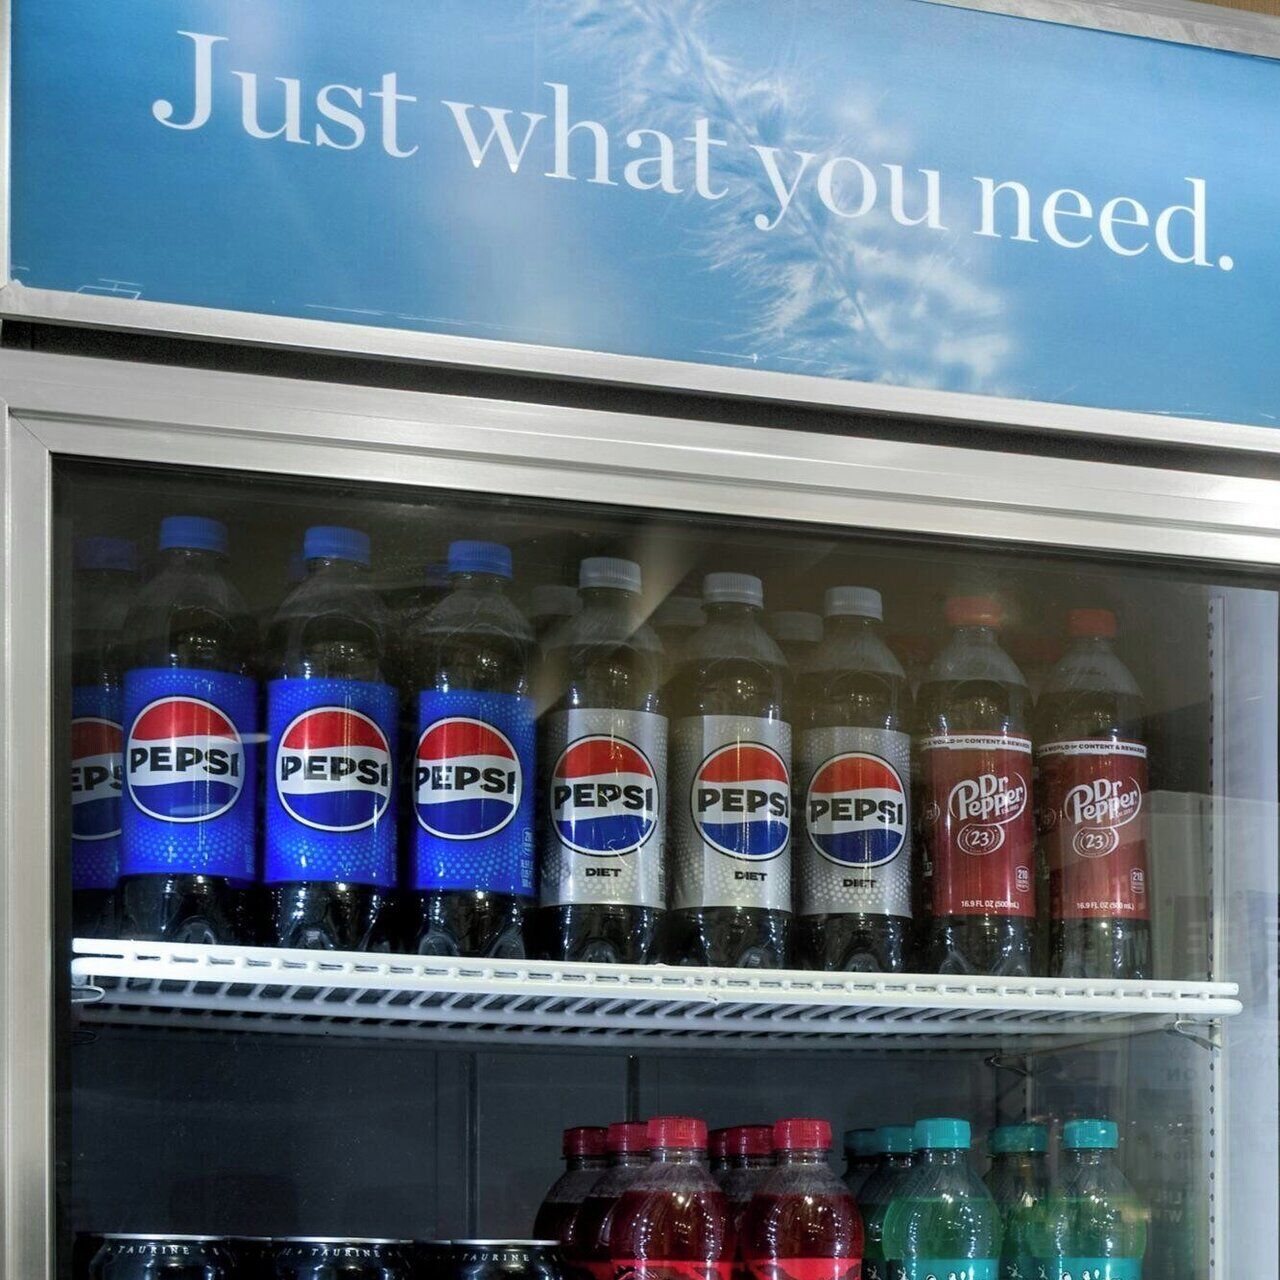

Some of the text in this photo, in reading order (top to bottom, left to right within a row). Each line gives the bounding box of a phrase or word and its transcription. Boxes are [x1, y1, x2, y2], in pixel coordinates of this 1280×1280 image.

[151, 30, 1237, 272] Just what you need.
[131, 747, 238, 777] PEPSI
[281, 756, 388, 787] PEPSI
[416, 765, 515, 795] PEPSI
[979, 774, 1008, 798] Dr
[1093, 779, 1122, 802] Dr
[554, 783, 653, 811] PEPSI
[698, 788, 788, 813] PEPSI
[957, 779, 1024, 821] Pepper
[1072, 783, 1139, 824] Pepper
[808, 796, 904, 825] PEPSI
[971, 830, 990, 846] 23
[1085, 834, 1104, 849] 23
[585, 867, 622, 878] DIET
[734, 871, 768, 882] DIET
[843, 878, 877, 889] DIET
[118, 1246, 190, 1256] TAURINE
[311, 1248, 382, 1258] TAURINE
[463, 1252, 530, 1262] TAURINE
